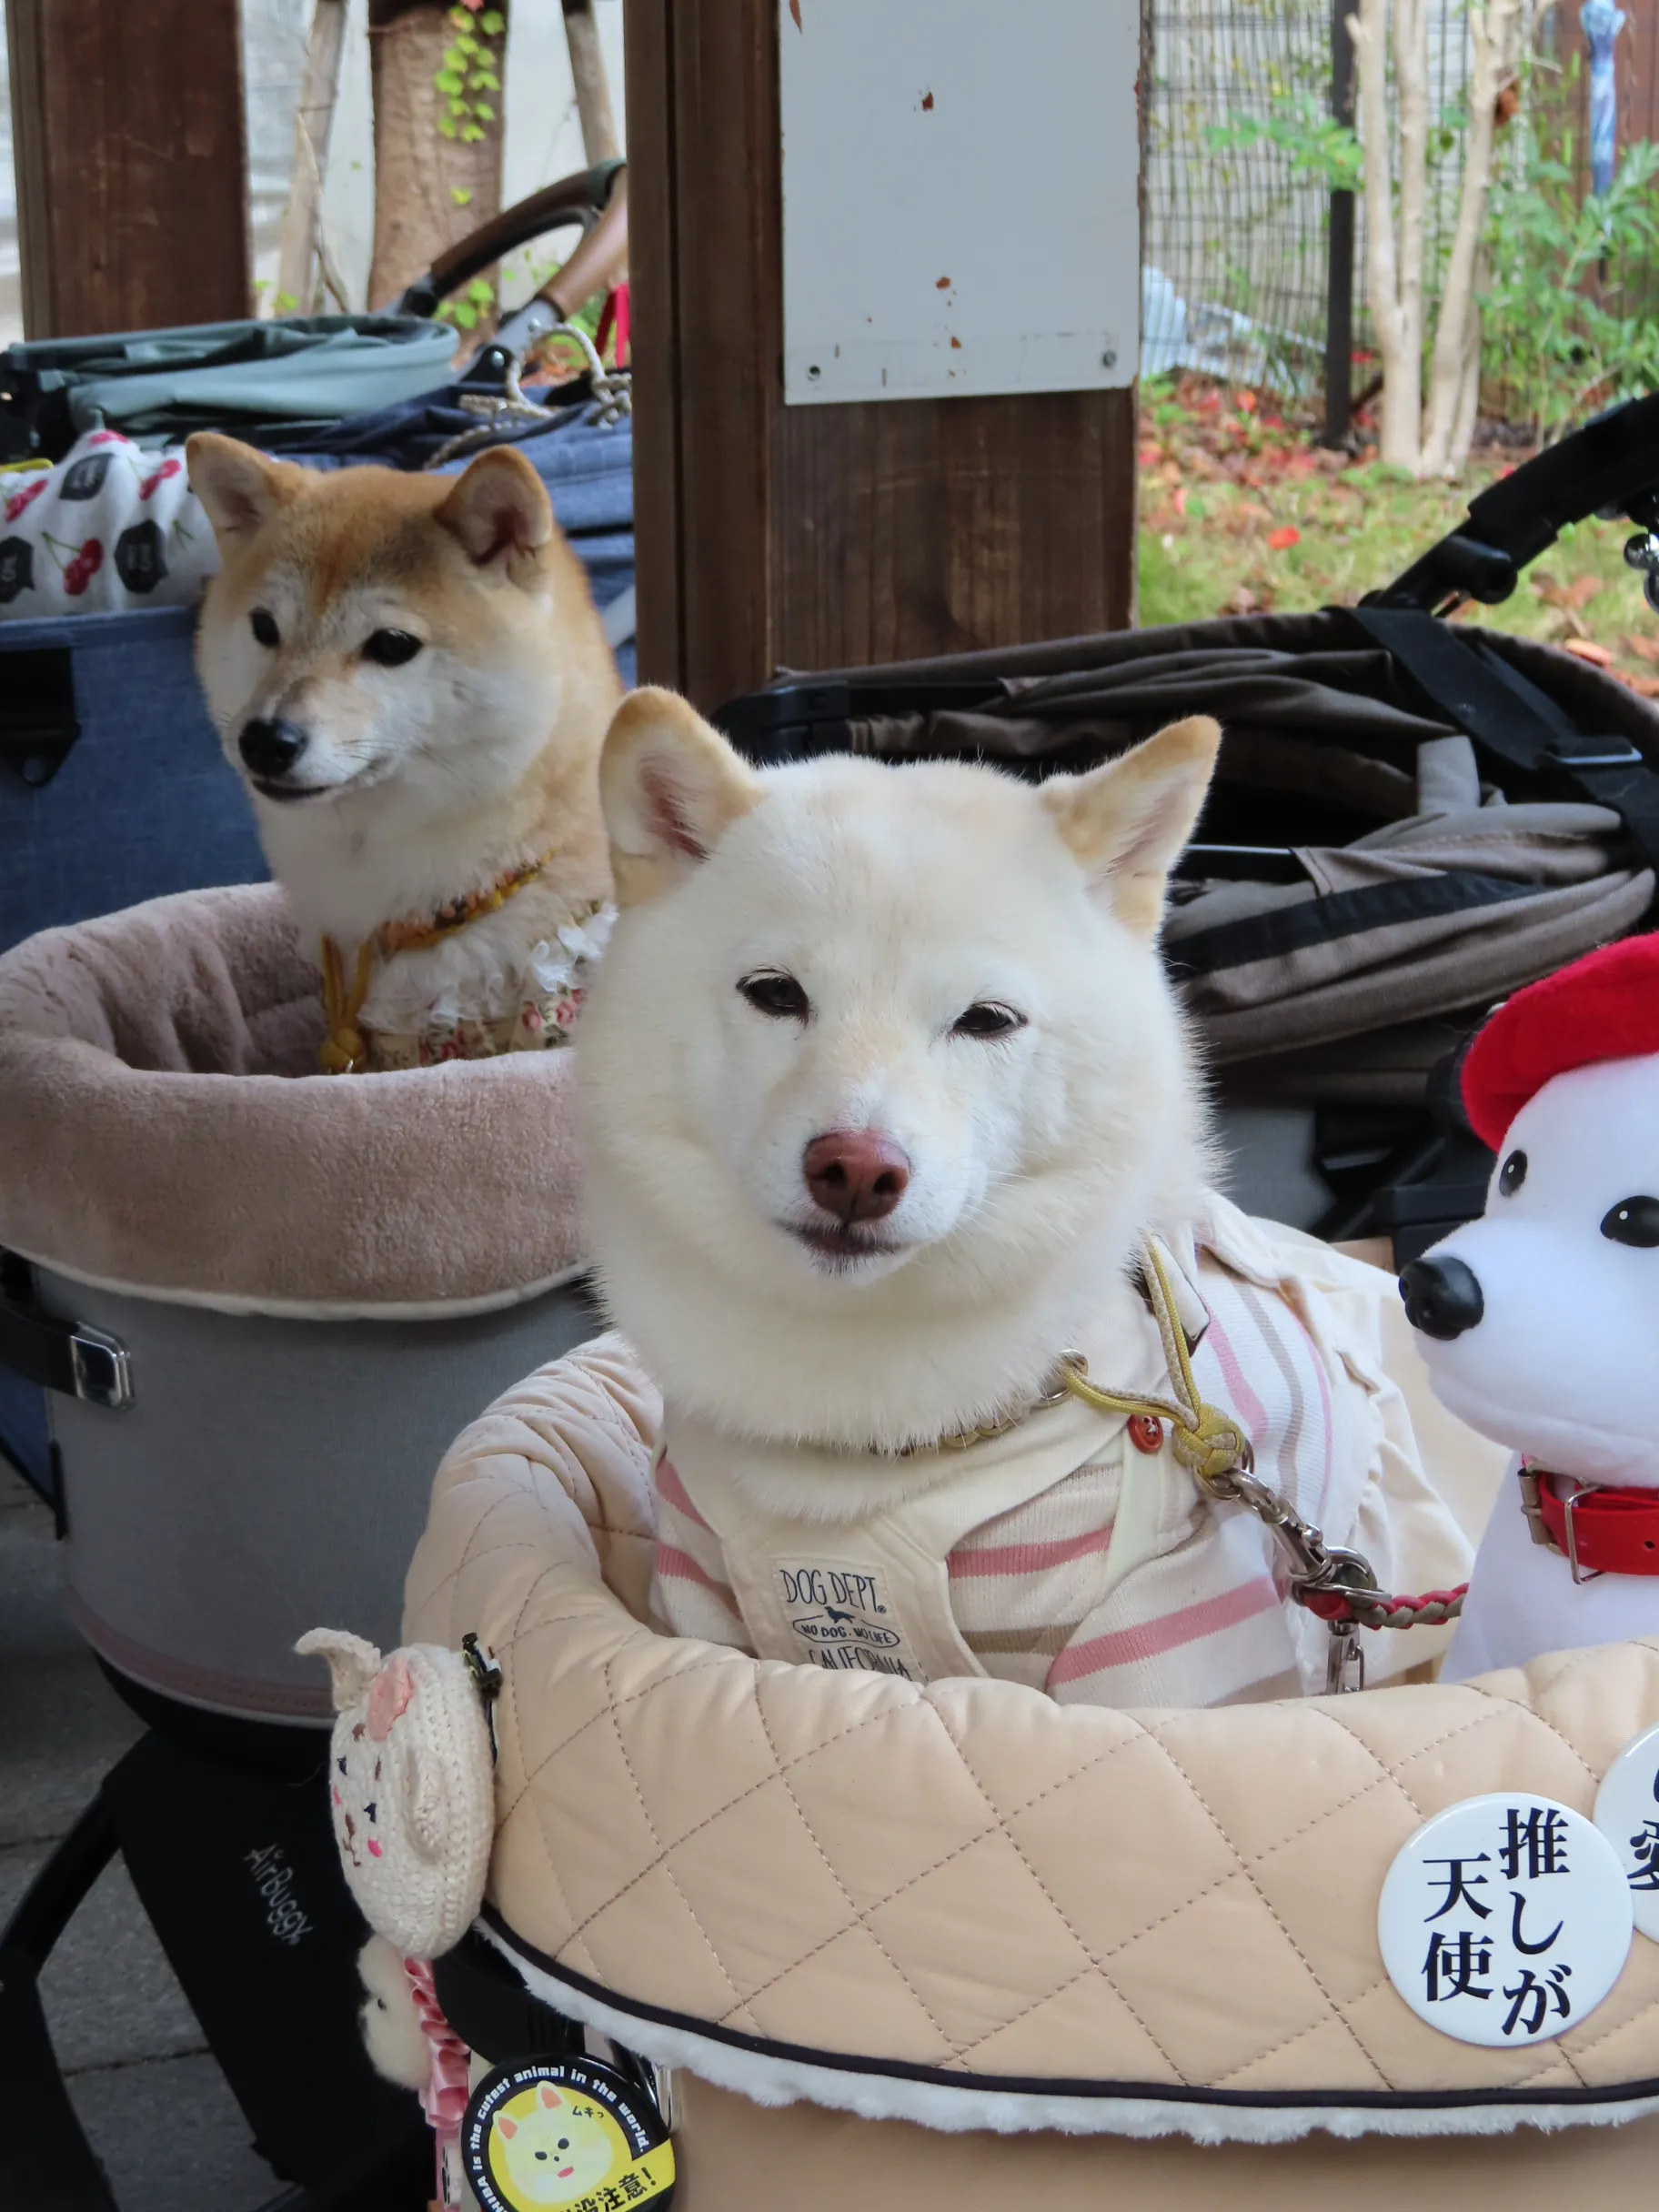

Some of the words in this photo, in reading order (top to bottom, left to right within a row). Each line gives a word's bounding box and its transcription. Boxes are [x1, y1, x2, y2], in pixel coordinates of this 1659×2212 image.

[779, 1569, 827, 1605] DOG
[801, 1624, 819, 1636] NO
[853, 1627, 869, 1640] NO
[869, 1630, 892, 1644] LIFE
[1421, 1852, 1494, 2002] 天使
[1498, 1806, 1573, 2036] 推しが
[513, 2066, 565, 2084] animal
[570, 2068, 588, 2085] in
[478, 2077, 511, 2120] cutest
[592, 2078, 618, 2104] the
[469, 2123, 483, 2150] the
[472, 2156, 484, 2171] is
[477, 2175, 508, 2212] HIBA
